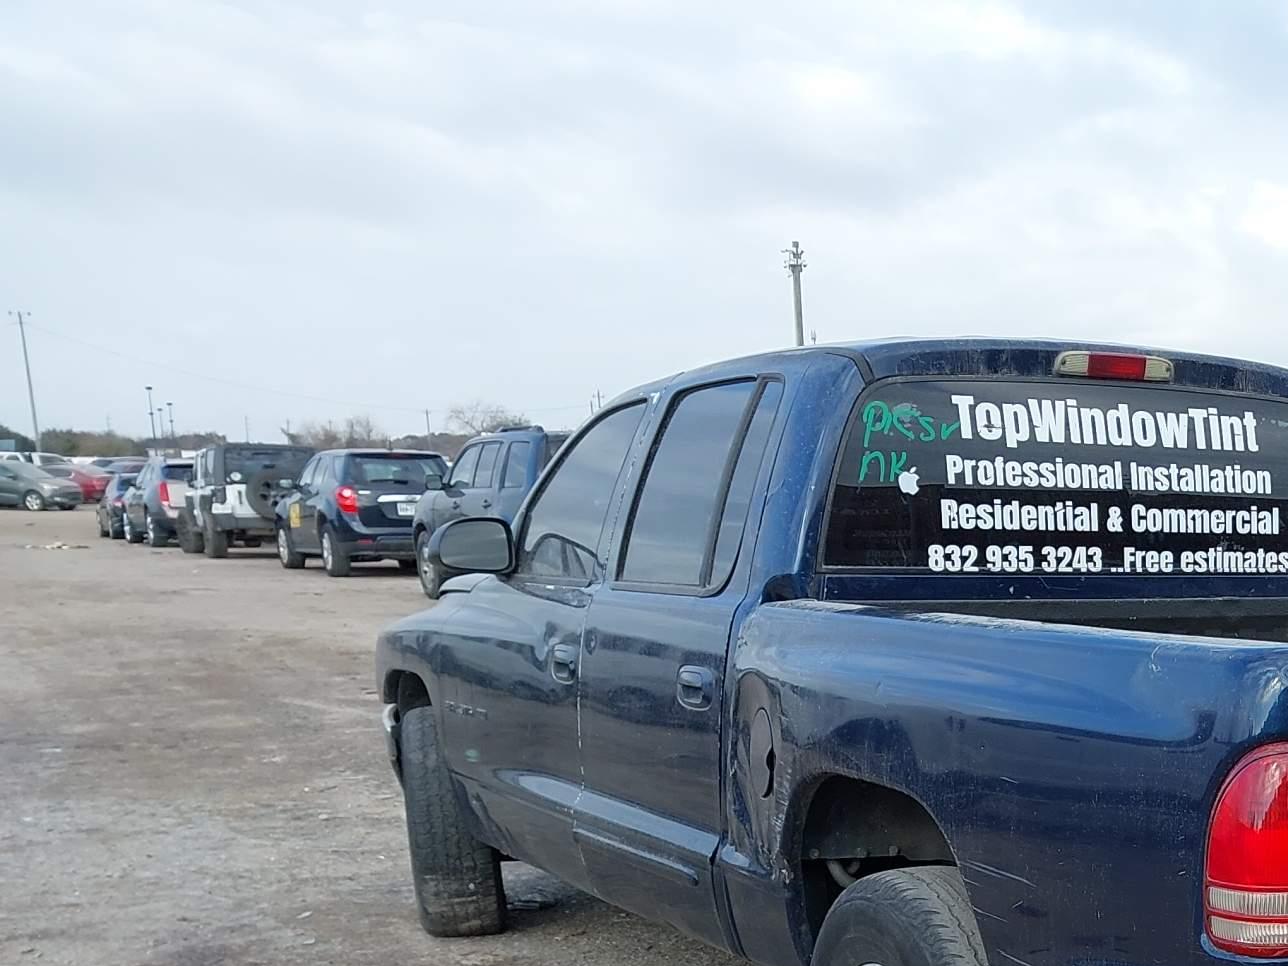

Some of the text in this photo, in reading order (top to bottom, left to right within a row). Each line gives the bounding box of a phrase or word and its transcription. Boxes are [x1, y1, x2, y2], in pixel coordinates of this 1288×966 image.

[951, 395, 1259, 452] TopWindowTint
[945, 454, 1272, 495] Professional Installation
[940, 498, 1280, 535] Residential & Commercial
[928, 544, 979, 573] 832
[985, 545, 1034, 573] 935
[1041, 546, 1102, 573] 3243
